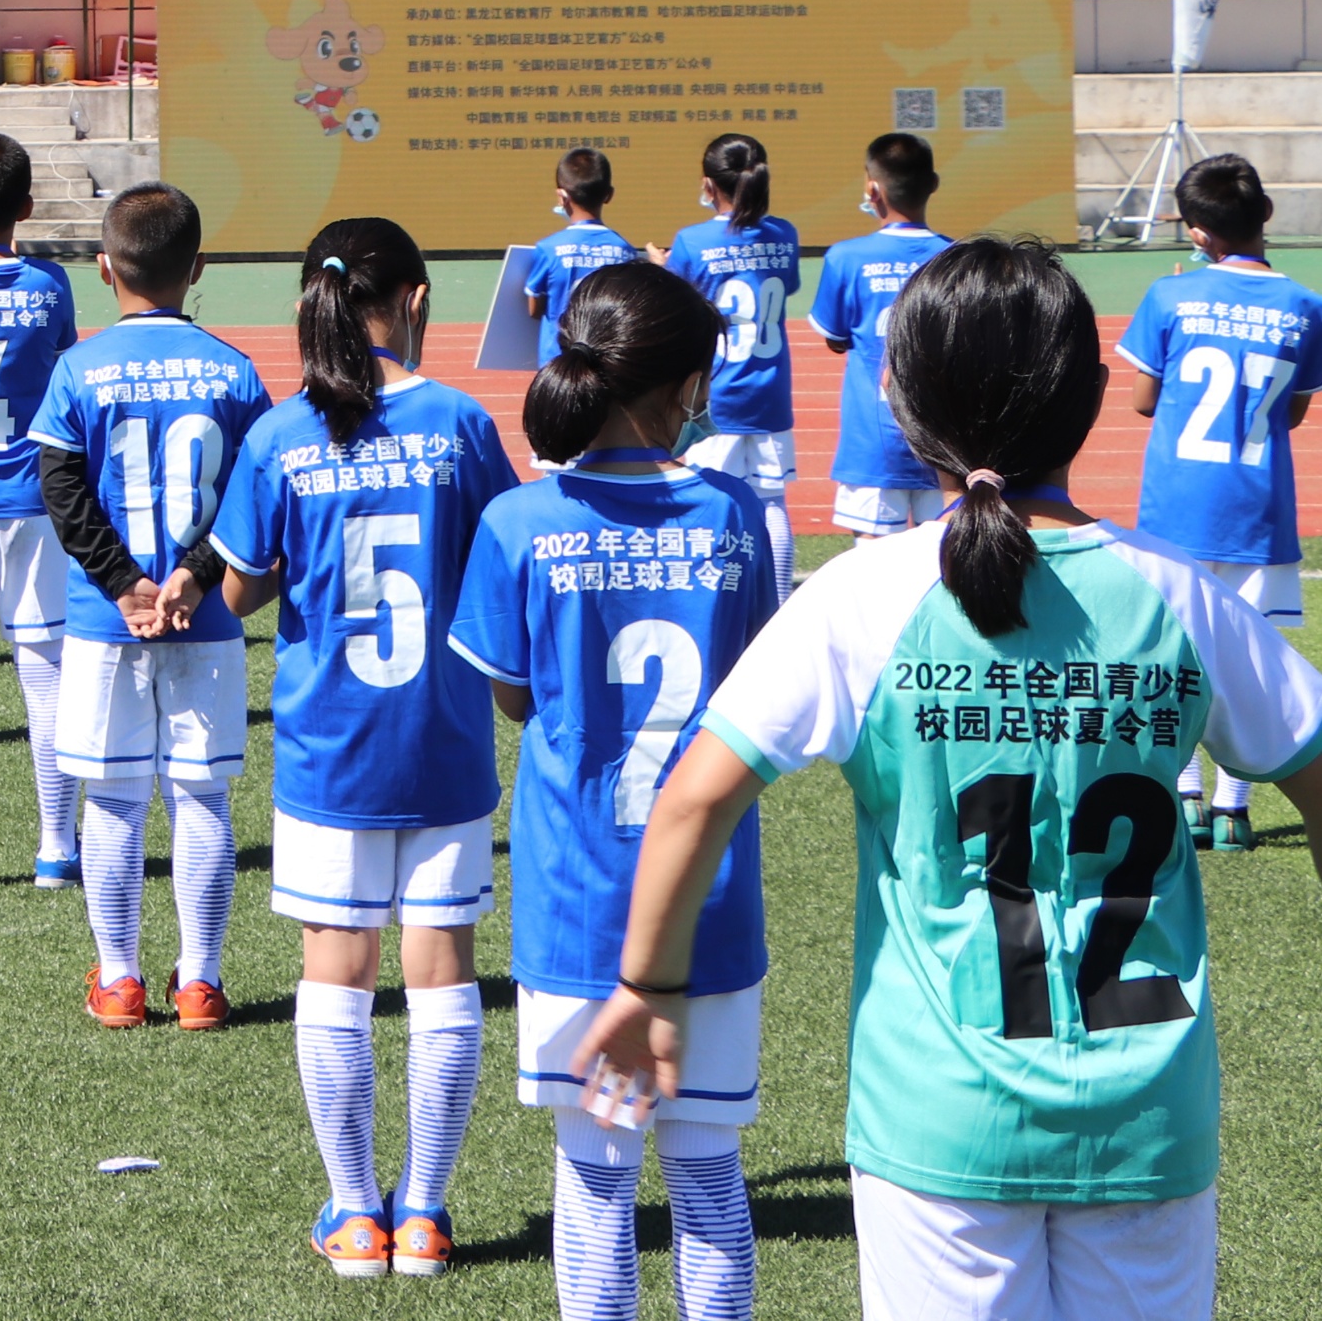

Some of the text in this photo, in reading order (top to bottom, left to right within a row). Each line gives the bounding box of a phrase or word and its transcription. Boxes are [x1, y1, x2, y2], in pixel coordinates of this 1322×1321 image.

[566, 84, 603, 97] 人民网
[95, 380, 229, 407] 校园足球夏令营
[1177, 346, 1298, 466] 27
[110, 414, 224, 555] 10
[290, 460, 454, 497] 校园足球夏令营
[343, 514, 427, 688] 5
[548, 561, 742, 594] 校园足球夏令营
[607, 619, 702, 826] 2
[914, 705, 1181, 748] 校园足球夏令营
[957, 772, 1197, 1039] 12
